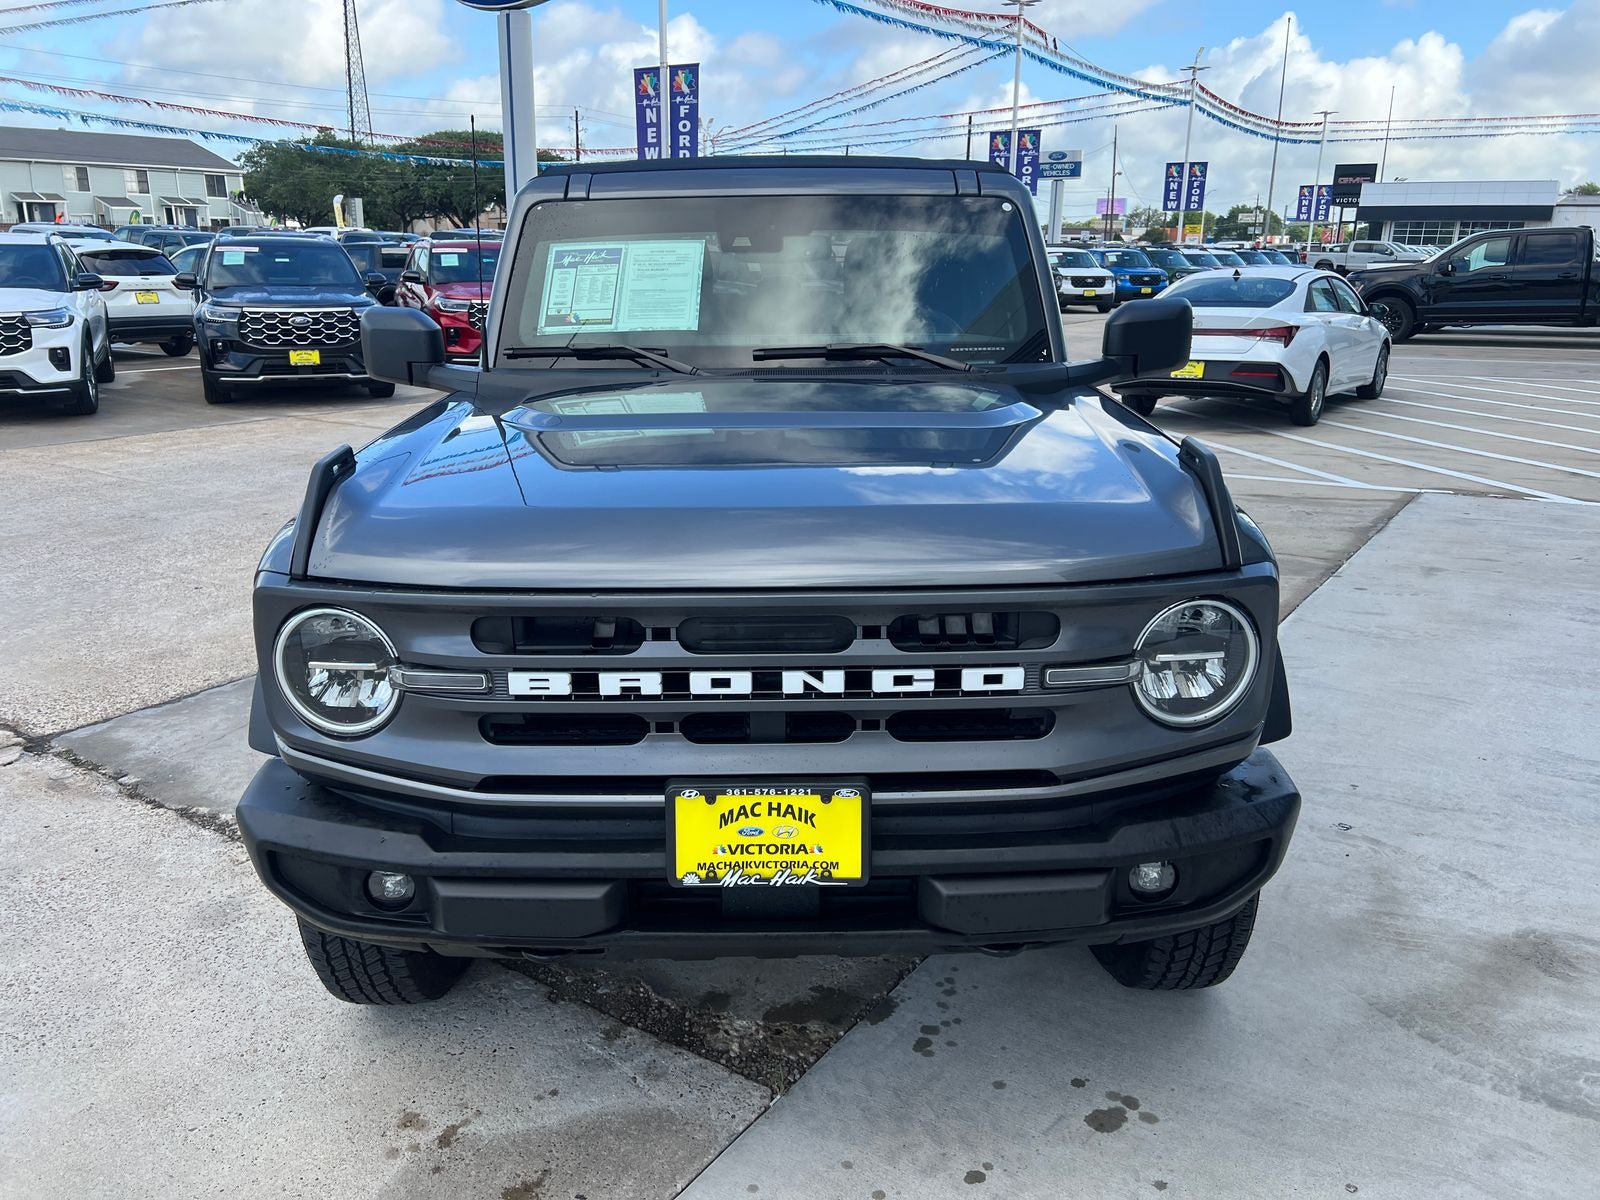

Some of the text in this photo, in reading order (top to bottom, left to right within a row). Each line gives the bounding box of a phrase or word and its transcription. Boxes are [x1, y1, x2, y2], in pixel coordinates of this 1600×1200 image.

[644, 107, 659, 159] NEW
[1338, 176, 1371, 184] GMC
[1167, 182, 1178, 209] NEW
[1190, 182, 1200, 209] FORD
[1300, 200, 1309, 220] NEW
[1318, 200, 1327, 220] FORD
[508, 666, 1025, 695] BRONCO
[719, 802, 816, 829] MAC HAIK
[740, 827, 762, 836] Ford
[727, 844, 809, 855] VICTORIA
[697, 860, 839, 871] MACHAIKVICTORIA.COM
[720, 868, 822, 888] Mac Haik
